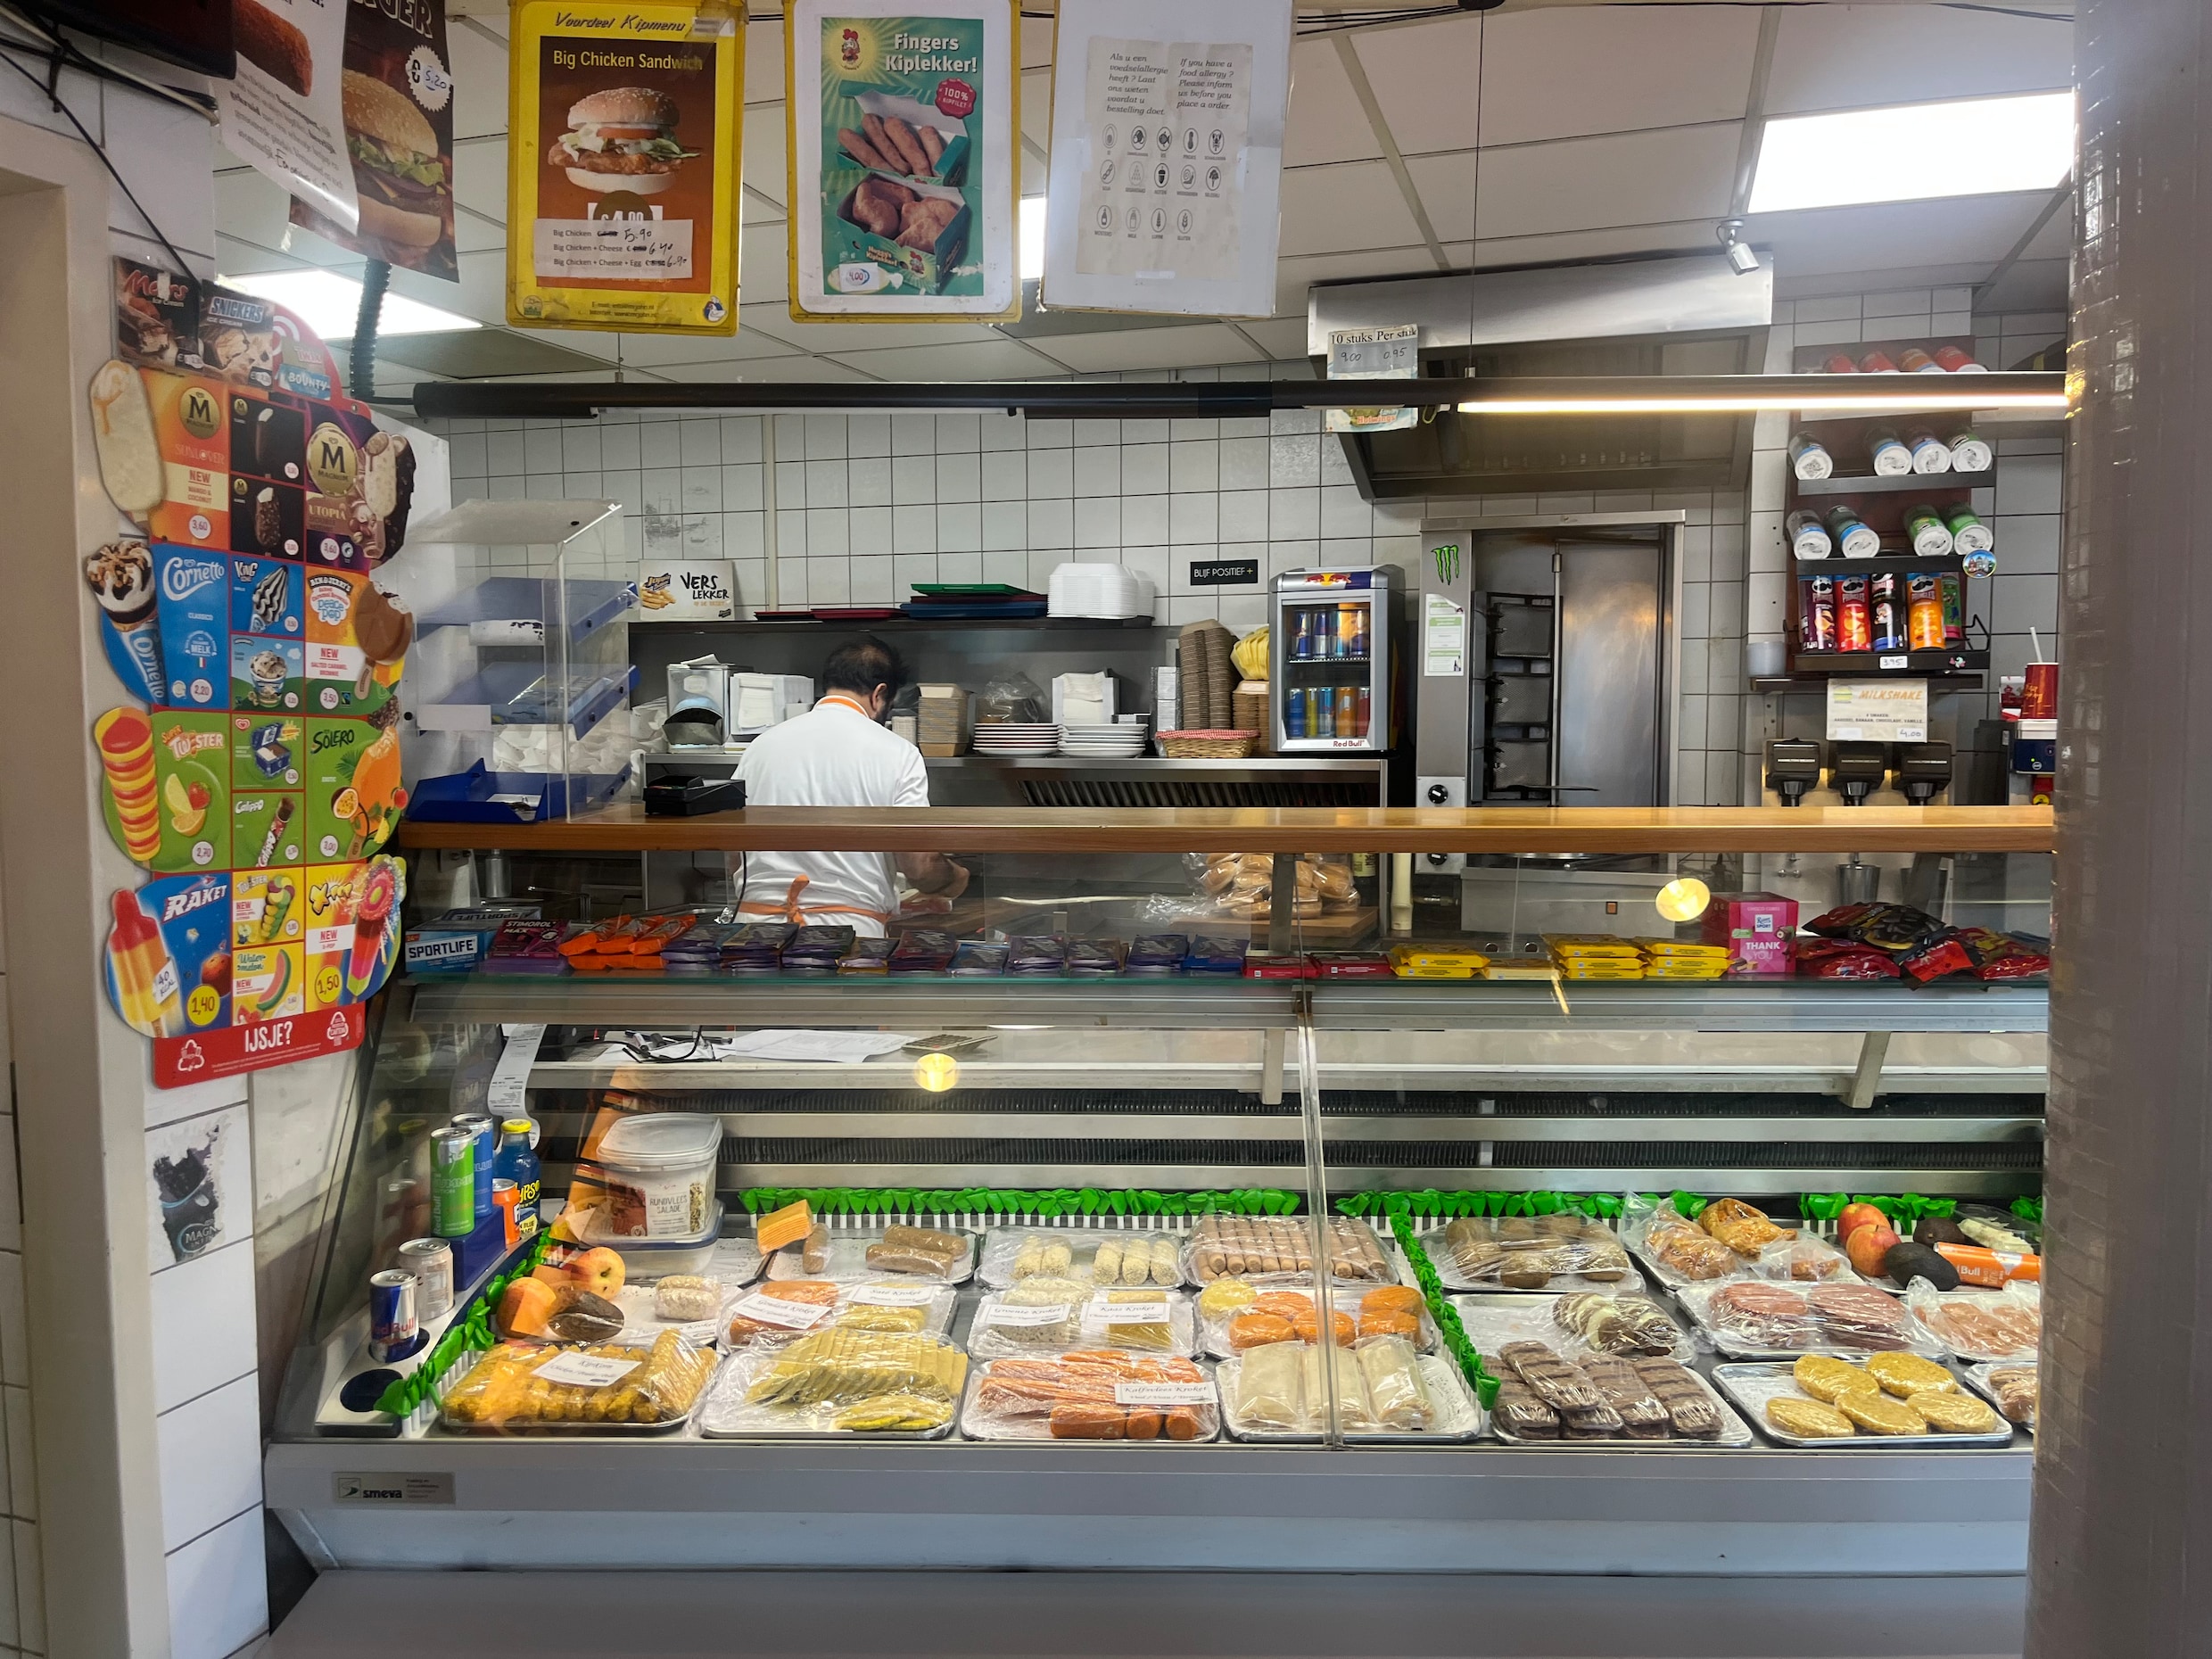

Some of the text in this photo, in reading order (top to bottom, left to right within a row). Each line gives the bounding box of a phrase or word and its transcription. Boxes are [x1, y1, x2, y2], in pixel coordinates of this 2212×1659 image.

[554, 12, 686, 33] Voordeel Kipmenu
[894, 33, 960, 54] Fingers
[553, 50, 703, 70] Big Chicken Sandwich
[1110, 54, 1123, 62] Als
[1179, 58, 1186, 66] If
[1205, 60, 1225, 68] have
[886, 55, 978, 75] Kiplekker!
[1110, 64, 1168, 75] voedselallergie
[1109, 74, 1129, 83] heeft
[1137, 75, 1156, 83] Laat
[1178, 69, 1197, 78] food
[1199, 70, 1226, 78] allergy
[1178, 79, 1233, 88] Please inform
[945, 87, 969, 102] 100%
[1124, 86, 1149, 94] weten
[1190, 90, 1215, 98] before
[1217, 93, 1232, 101] you
[1107, 95, 1137, 103] voordat
[1106, 105, 1144, 116] bestelling
[1176, 101, 1199, 109] place
[553, 229, 565, 237] Big
[565, 229, 592, 237] Chicken
[553, 244, 565, 252] Big
[565, 244, 592, 252] Chicken
[599, 244, 623, 252] Cheese
[553, 258, 565, 267] Big
[565, 258, 592, 267] Chicken
[598, 259, 623, 267] Cheese
[630, 260, 642, 268] Egg
[211, 298, 264, 322] SNICKERS
[1332, 326, 1417, 345] 10 stuks Per stuk
[288, 372, 330, 391] BOUNTY
[320, 441, 346, 474] M
[189, 469, 210, 483] NEW
[309, 504, 347, 520] UTOPIA
[1212, 566, 1246, 577] POSITIEF
[162, 557, 226, 602] Cornetto
[680, 571, 719, 590] VERS
[692, 589, 730, 600] LEKKER
[190, 644, 211, 655] MELK
[320, 648, 339, 659] NEW
[1858, 689, 1924, 701] MILKSHAKE
[310, 729, 355, 755] SOLERO
[1348, 739, 1363, 747] Bull
[162, 884, 228, 922] RAKET
[235, 901, 252, 911] NEW
[319, 929, 338, 940] NEW
[408, 939, 475, 959] SPORTLIFE
[1746, 941, 1781, 950] THANK
[1754, 950, 1773, 961] YOU
[235, 978, 252, 988] NEW
[317, 974, 341, 995] 1,50
[191, 996, 216, 1016] 1,40
[244, 1020, 293, 1053] IJSJE?
[649, 1194, 689, 1207] RUNDVLEES
[433, 1196, 442, 1234] Red Bull
[656, 1205, 681, 1214] SALADE
[1960, 1266, 1981, 1276] Bull
[392, 1317, 416, 1333] Bull
[363, 1490, 403, 1498] smeva
